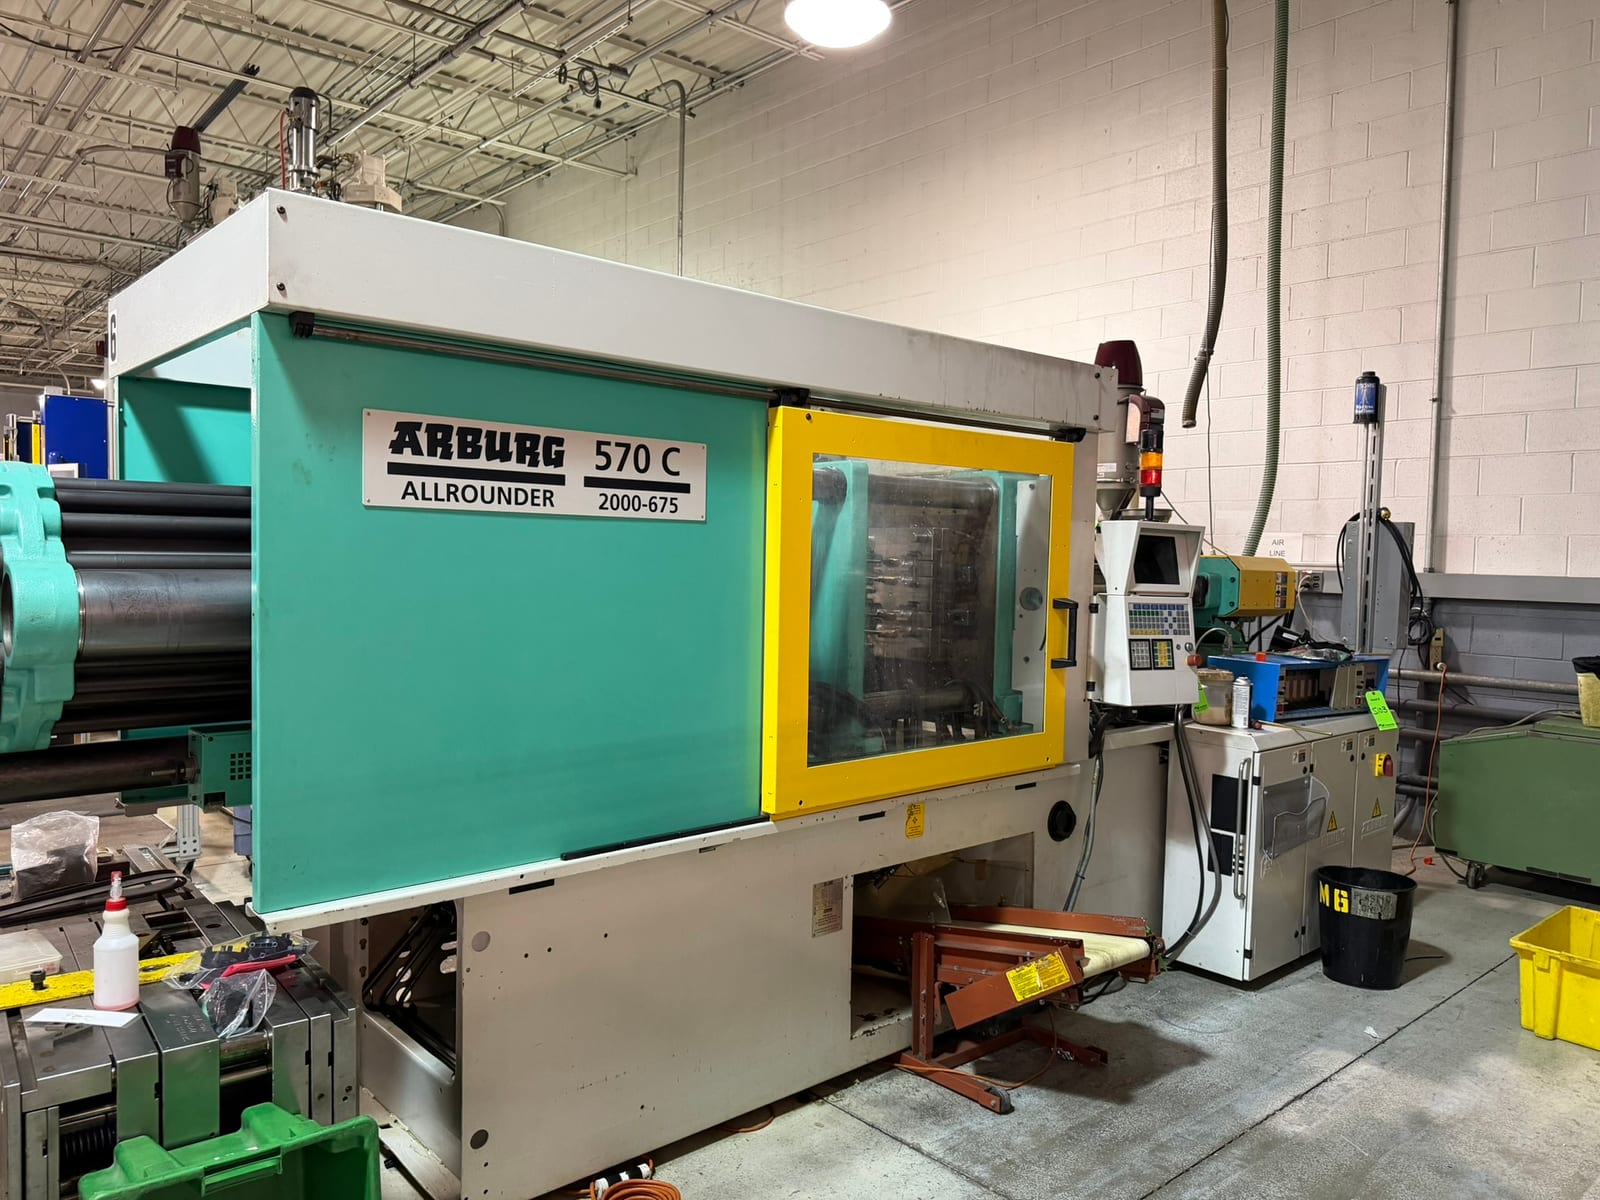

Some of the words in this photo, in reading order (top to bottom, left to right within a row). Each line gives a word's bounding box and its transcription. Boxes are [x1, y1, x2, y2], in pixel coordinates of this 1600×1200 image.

[110, 313, 117, 362] 6
[388, 420, 566, 469] ARBURG
[595, 440, 651, 474] 570
[661, 446, 681, 477] C
[400, 480, 555, 508] ALLROUNDER
[598, 493, 679, 514] 2000-675
[1269, 549, 1286, 557] LINE
[1271, 538, 1285, 546] AIR
